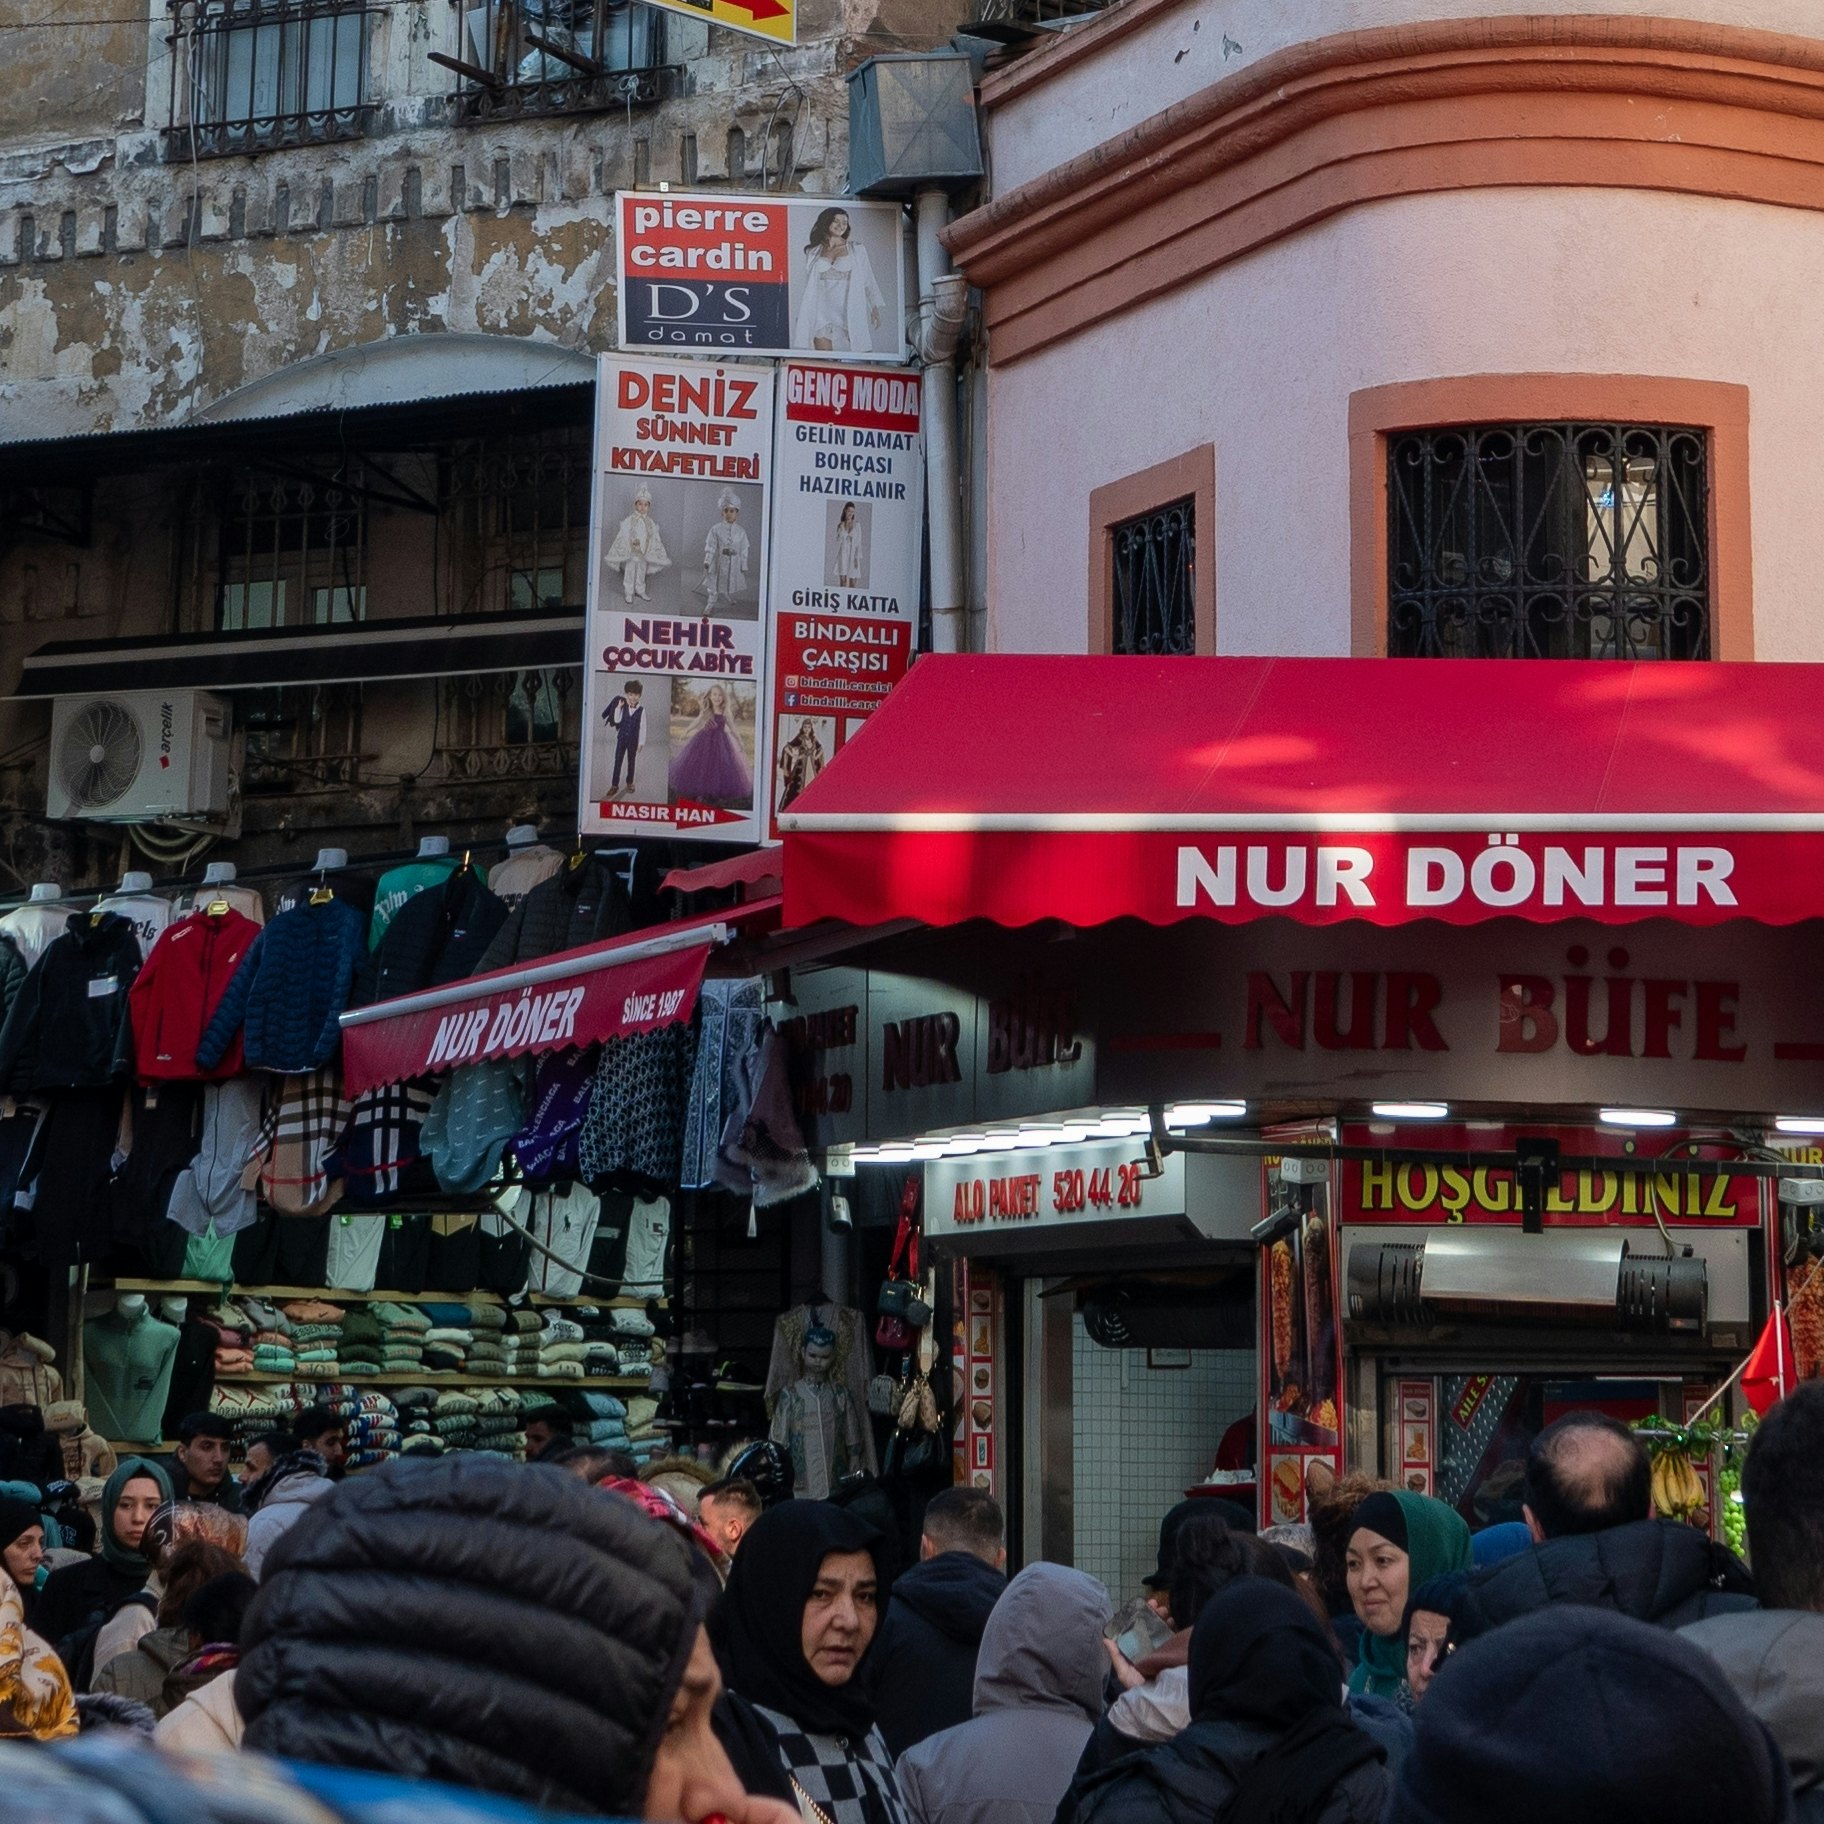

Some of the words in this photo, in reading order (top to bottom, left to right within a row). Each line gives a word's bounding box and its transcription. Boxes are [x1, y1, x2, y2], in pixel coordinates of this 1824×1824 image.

[634, 201, 769, 234] pierre
[630, 241, 774, 273] cardin
[647, 327, 753, 345] damat
[617, 368, 758, 420] DENİZ
[787, 368, 847, 415] GENÇ
[852, 377, 920, 416] MODA
[636, 415, 737, 447] SÜNNET
[795, 422, 847, 448] GELİN
[852, 430, 914, 452] DAMAT
[612, 446, 760, 480] KIYAFETLERİ
[814, 452, 893, 476] BOHÇASI
[799, 476, 906, 500] HAZIRLANIR
[792, 587, 841, 612] GİRİŞ
[847, 595, 900, 614] KATTA
[624, 616, 735, 650] NEHİR
[794, 616, 899, 646] BİNDALLI
[602, 646, 687, 674] ÇOCUK
[691, 649, 753, 675] ABİYE
[801, 648, 889, 674] ÇARŞISI
[160, 701, 174, 754] arçelik
[611, 802, 670, 821] NASIR
[674, 805, 716, 824] HAN
[1177, 847, 1376, 907] NUR
[1406, 834, 1738, 908] DÖNER
[1245, 969, 1450, 1054] NUR
[1496, 946, 1747, 1062] BÜFE
[426, 1007, 490, 1065] NUR
[485, 985, 586, 1055] DÖNER
[622, 988, 655, 1025] SİNCE
[658, 987, 686, 1020] 1987
[882, 1011, 963, 1092] NUR
[987, 970, 1083, 1074] BÜFE
[953, 1179, 985, 1225] ALO
[989, 1173, 1043, 1222] PAKET
[1052, 1171, 1084, 1213] 520
[1088, 1169, 1113, 1207] 44
[1117, 1164, 1142, 1206] 20
